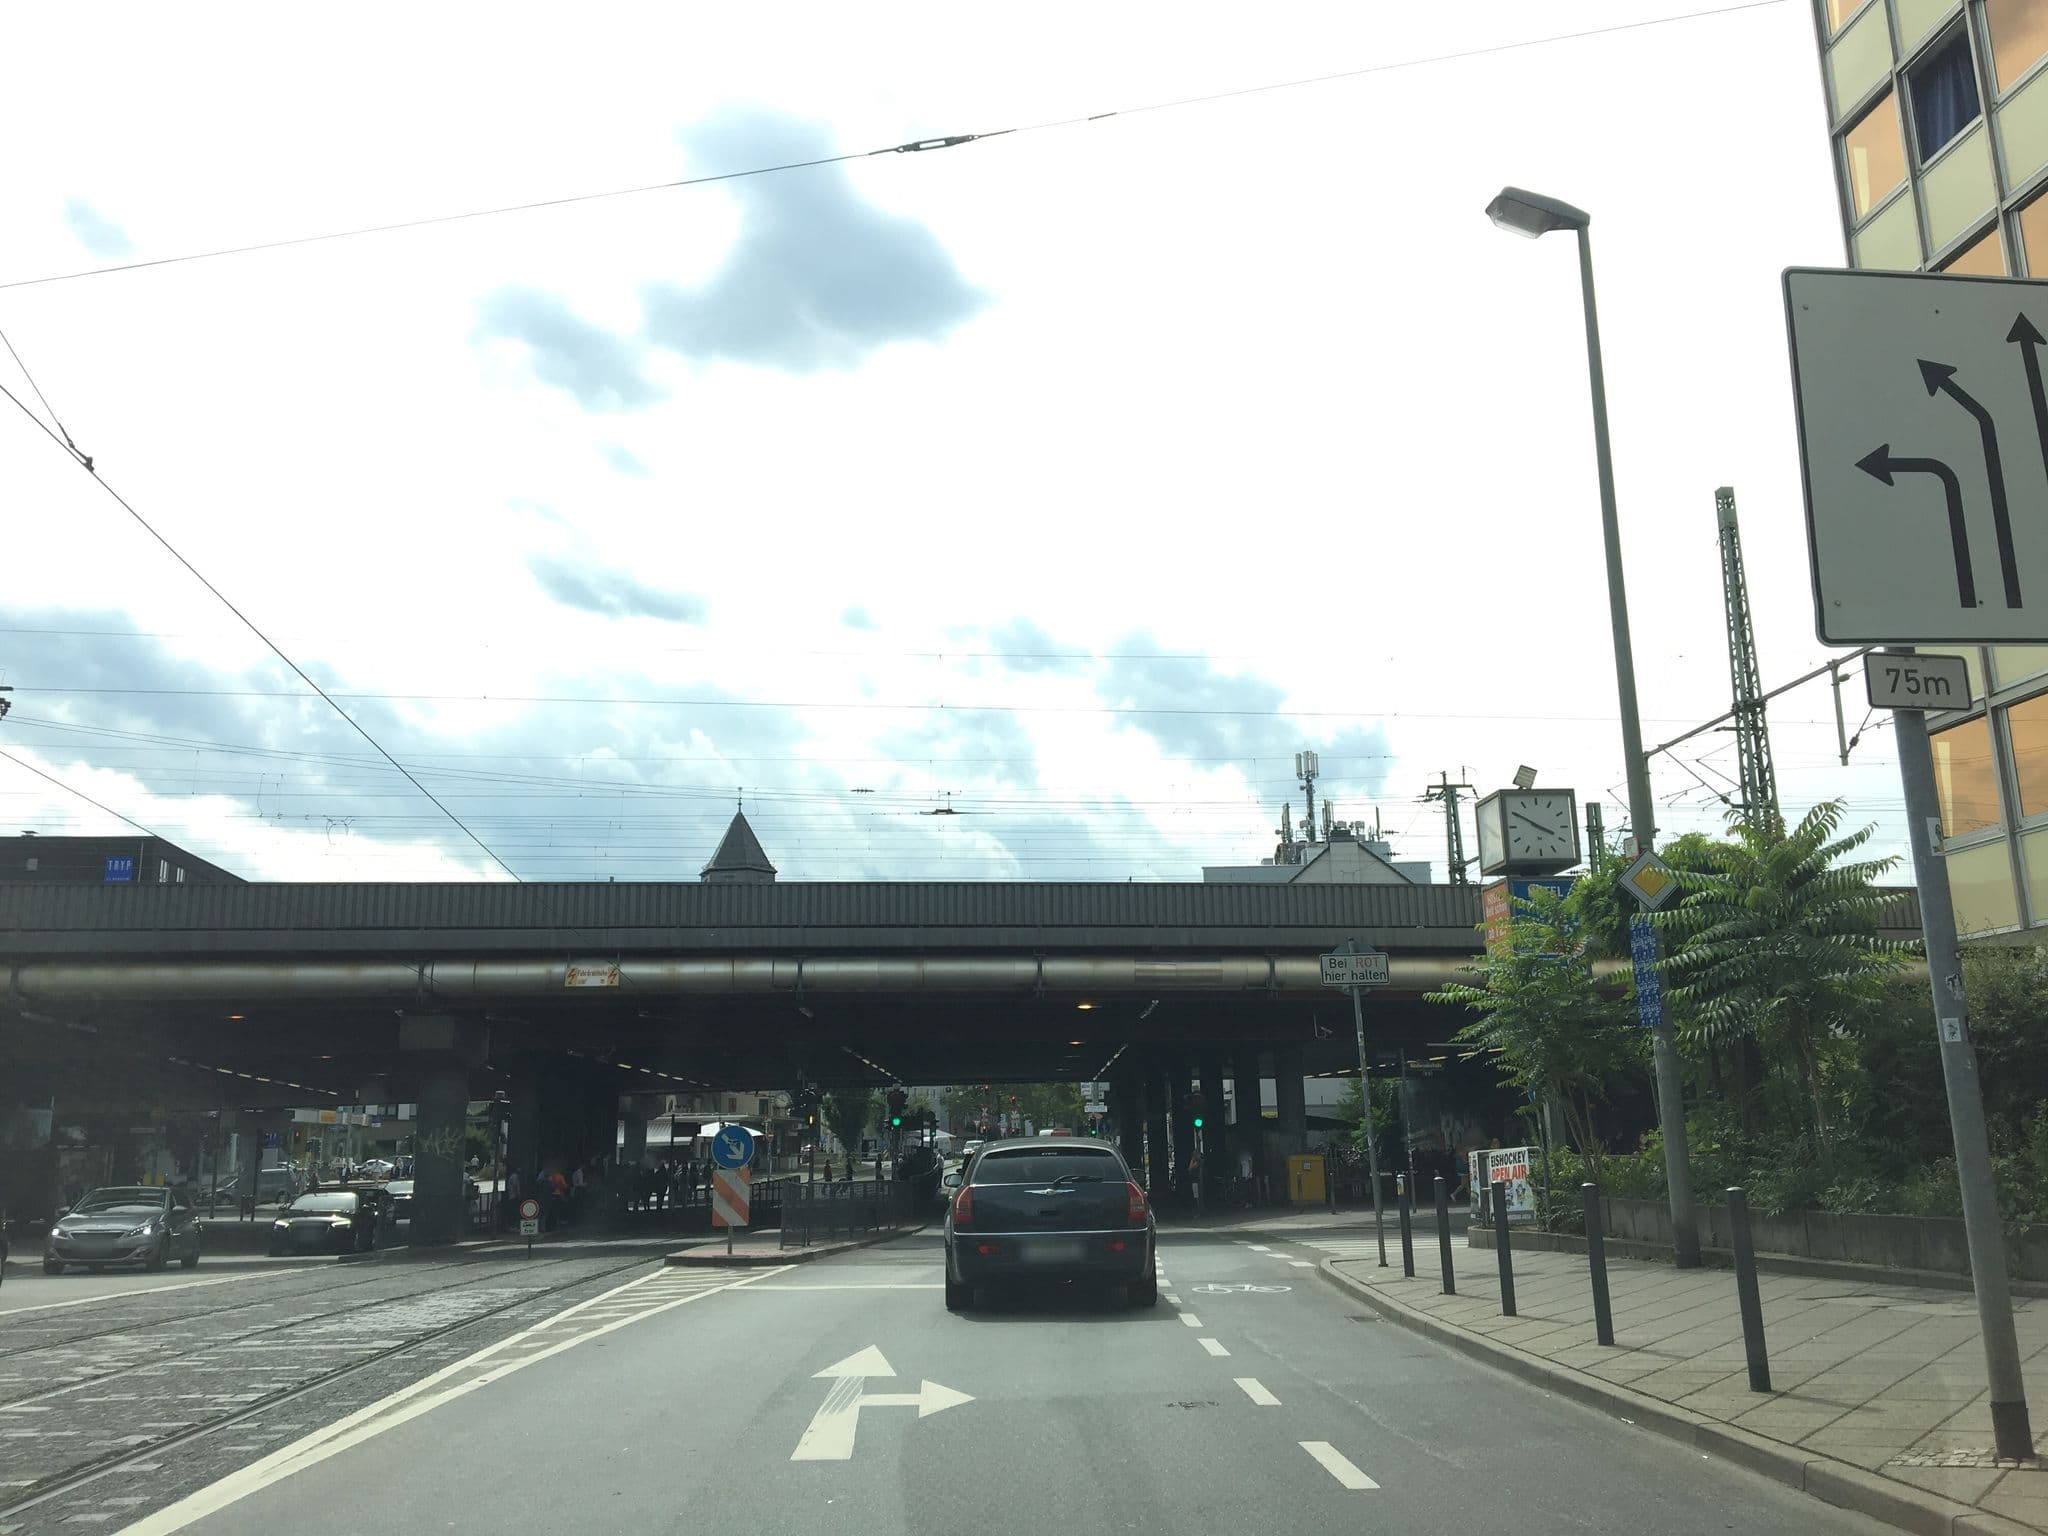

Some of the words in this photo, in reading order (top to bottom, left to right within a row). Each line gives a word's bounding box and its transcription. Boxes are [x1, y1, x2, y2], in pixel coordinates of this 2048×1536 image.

[1885, 668, 1951, 695] 75m
[1329, 958, 1347, 969] Bei
[1356, 957, 1381, 968] ROT
[1324, 971, 1346, 981] hier
[1351, 970, 1386, 981] halten
[1491, 1151, 1526, 1167] EISHOCKEY
[1492, 1167, 1510, 1181] OPEN
[1512, 1164, 1527, 1179] AIR
